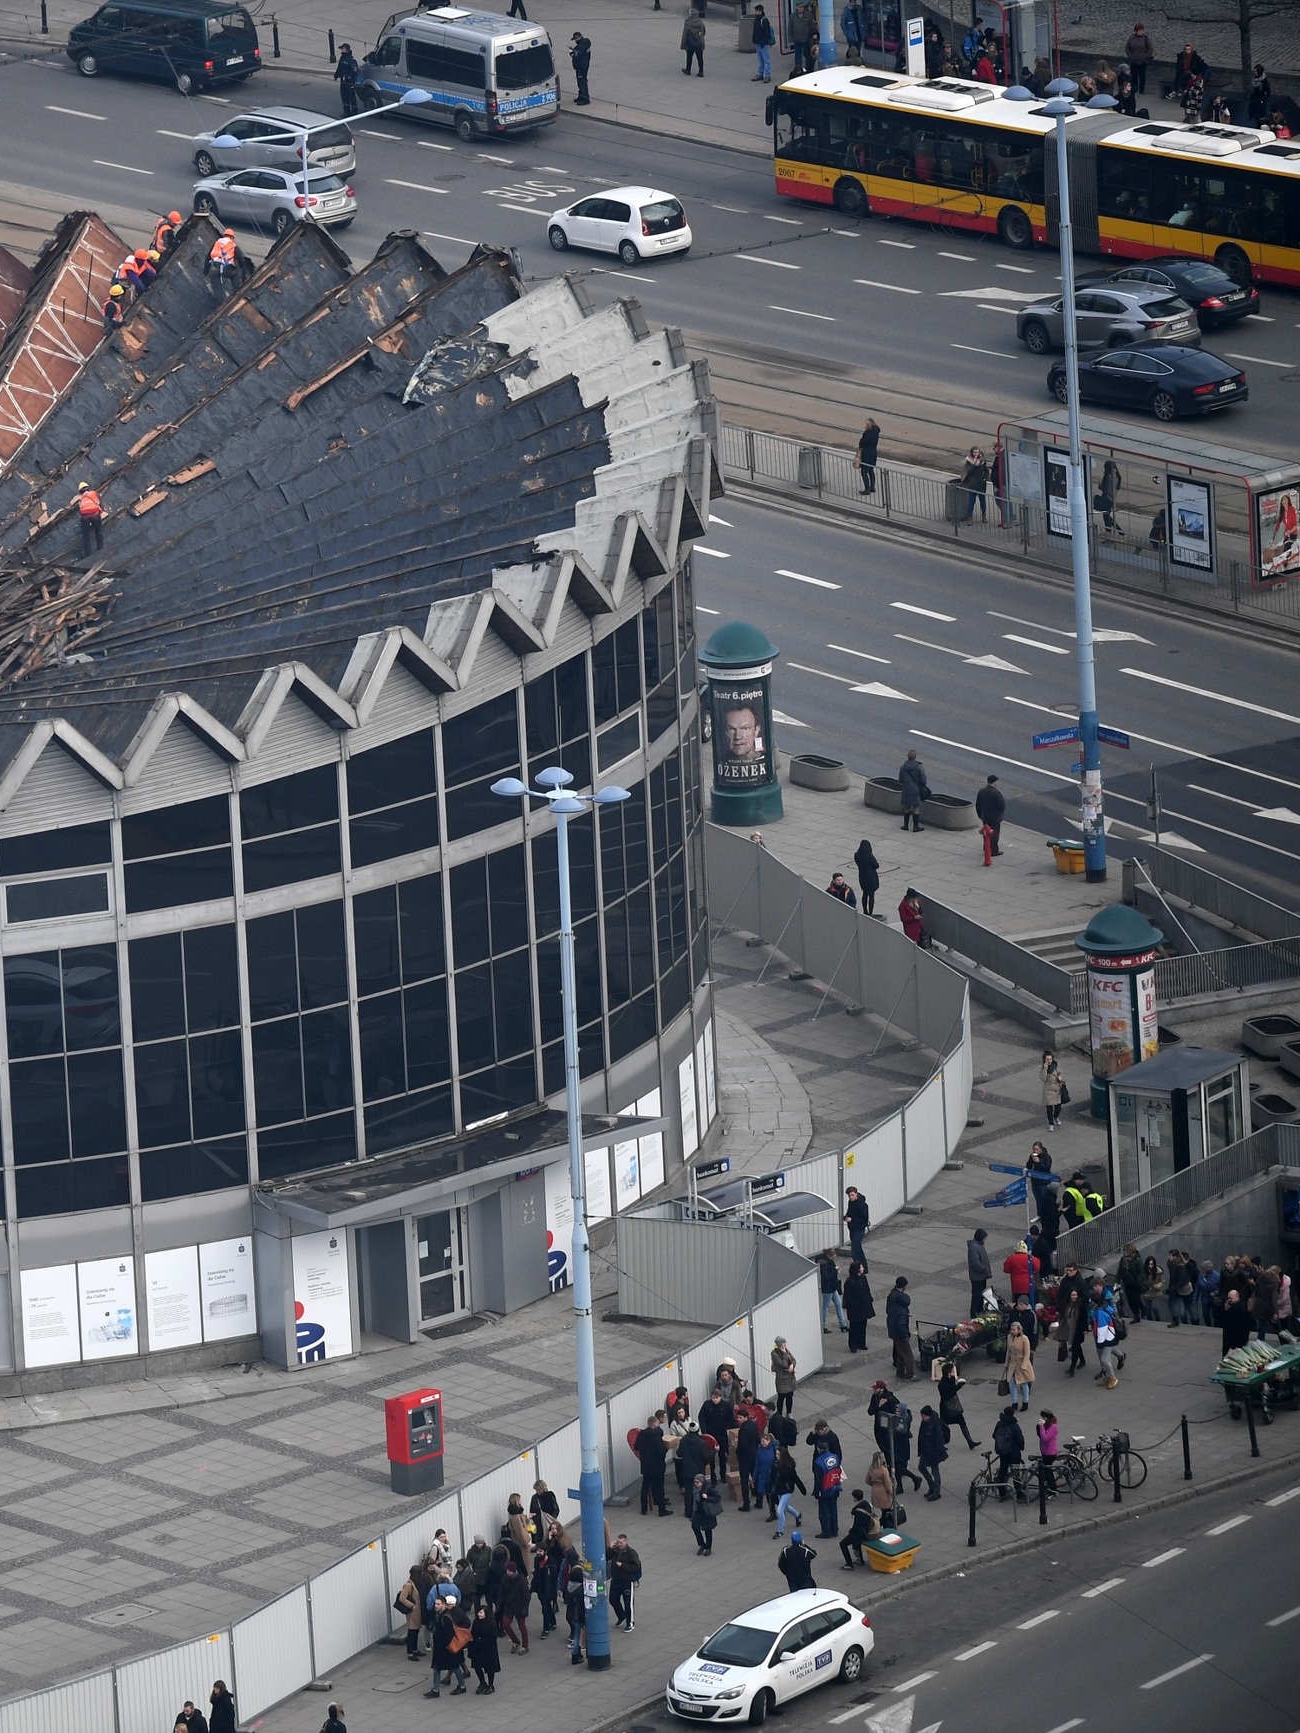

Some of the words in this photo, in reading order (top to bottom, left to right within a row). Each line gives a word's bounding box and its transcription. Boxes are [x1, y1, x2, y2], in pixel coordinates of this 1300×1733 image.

[500, 100, 527, 112] POLICJA
[546, 93, 556, 101] 906
[778, 168, 795, 178] 2007
[482, 180, 576, 202] BUS
[713, 690, 731, 699] Teatr
[1040, 732, 1073, 744] Marszałkowska
[718, 762, 766, 777] OŻENEK
[1141, 952, 1154, 964] KFC
[1093, 980, 1123, 992] KFC
[697, 1168, 719, 1178] bankomat
[752, 1182, 774, 1193] bankomat
[817, 1652, 830, 1666] TVP
[704, 1664, 727, 1674] TVP
[789, 1661, 813, 1676] TELEWIZJA
[796, 1668, 813, 1680] POLSKA
[688, 1677, 713, 1685] POLSKA
[689, 1672, 723, 1682] TELEWIZJA
